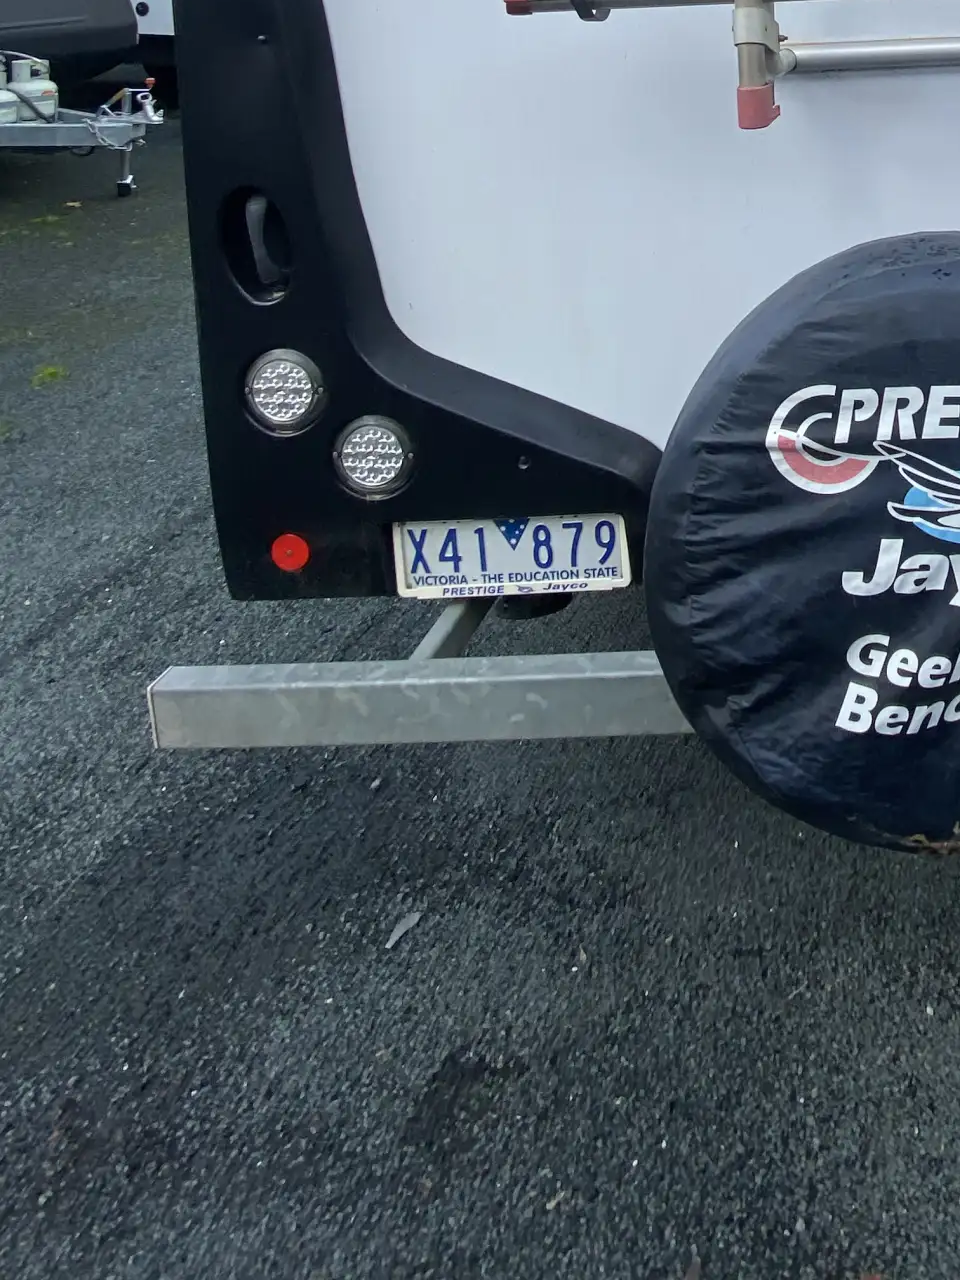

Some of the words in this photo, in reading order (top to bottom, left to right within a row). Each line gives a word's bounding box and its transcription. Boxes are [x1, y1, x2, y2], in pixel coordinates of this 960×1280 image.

[407, 527, 488, 574] X41
[532, 520, 616, 569] 879
[413, 575, 468, 586] VICTORIA
[482, 573, 504, 583] THE
[508, 569, 580, 582] EDUCATION
[584, 567, 618, 578] STATE
[442, 584, 505, 596] PRESTIGE
[542, 581, 589, 591] Jayco
